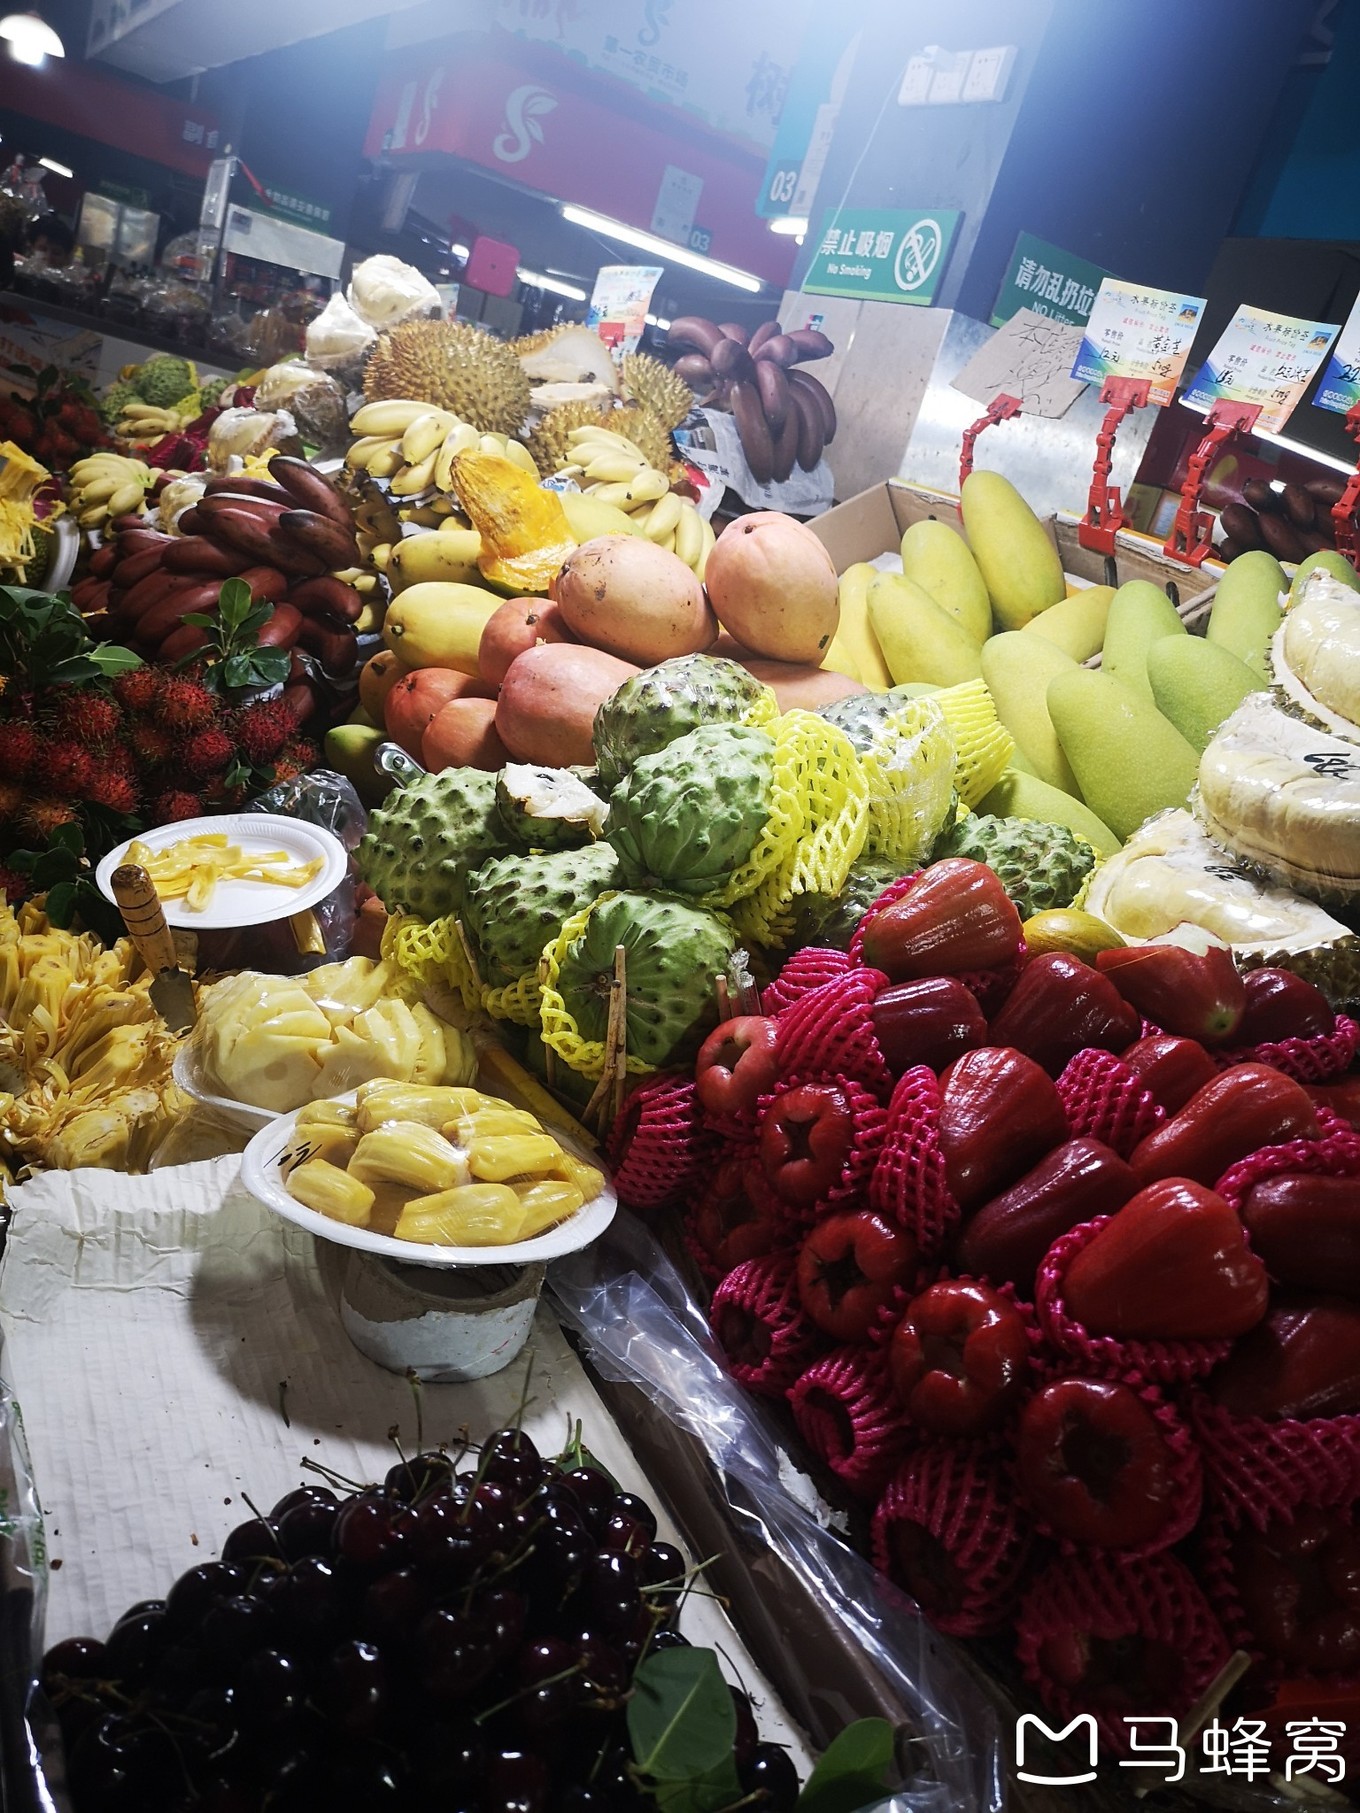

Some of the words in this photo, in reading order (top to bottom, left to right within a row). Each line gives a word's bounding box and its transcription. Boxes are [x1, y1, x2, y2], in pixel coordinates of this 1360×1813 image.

[770, 170, 798, 203] 03
[690, 230, 711, 252] 03
[820, 228, 895, 259] 禁止吸烟
[826, 263, 838, 275] No
[838, 263, 873, 280] Smoking
[1014, 256, 1099, 317] 请勿乱扔垃
[1031, 301, 1049, 316] NO
[1104, 328, 1125, 341] 零售价
[1228, 354, 1248, 368] 零售价
